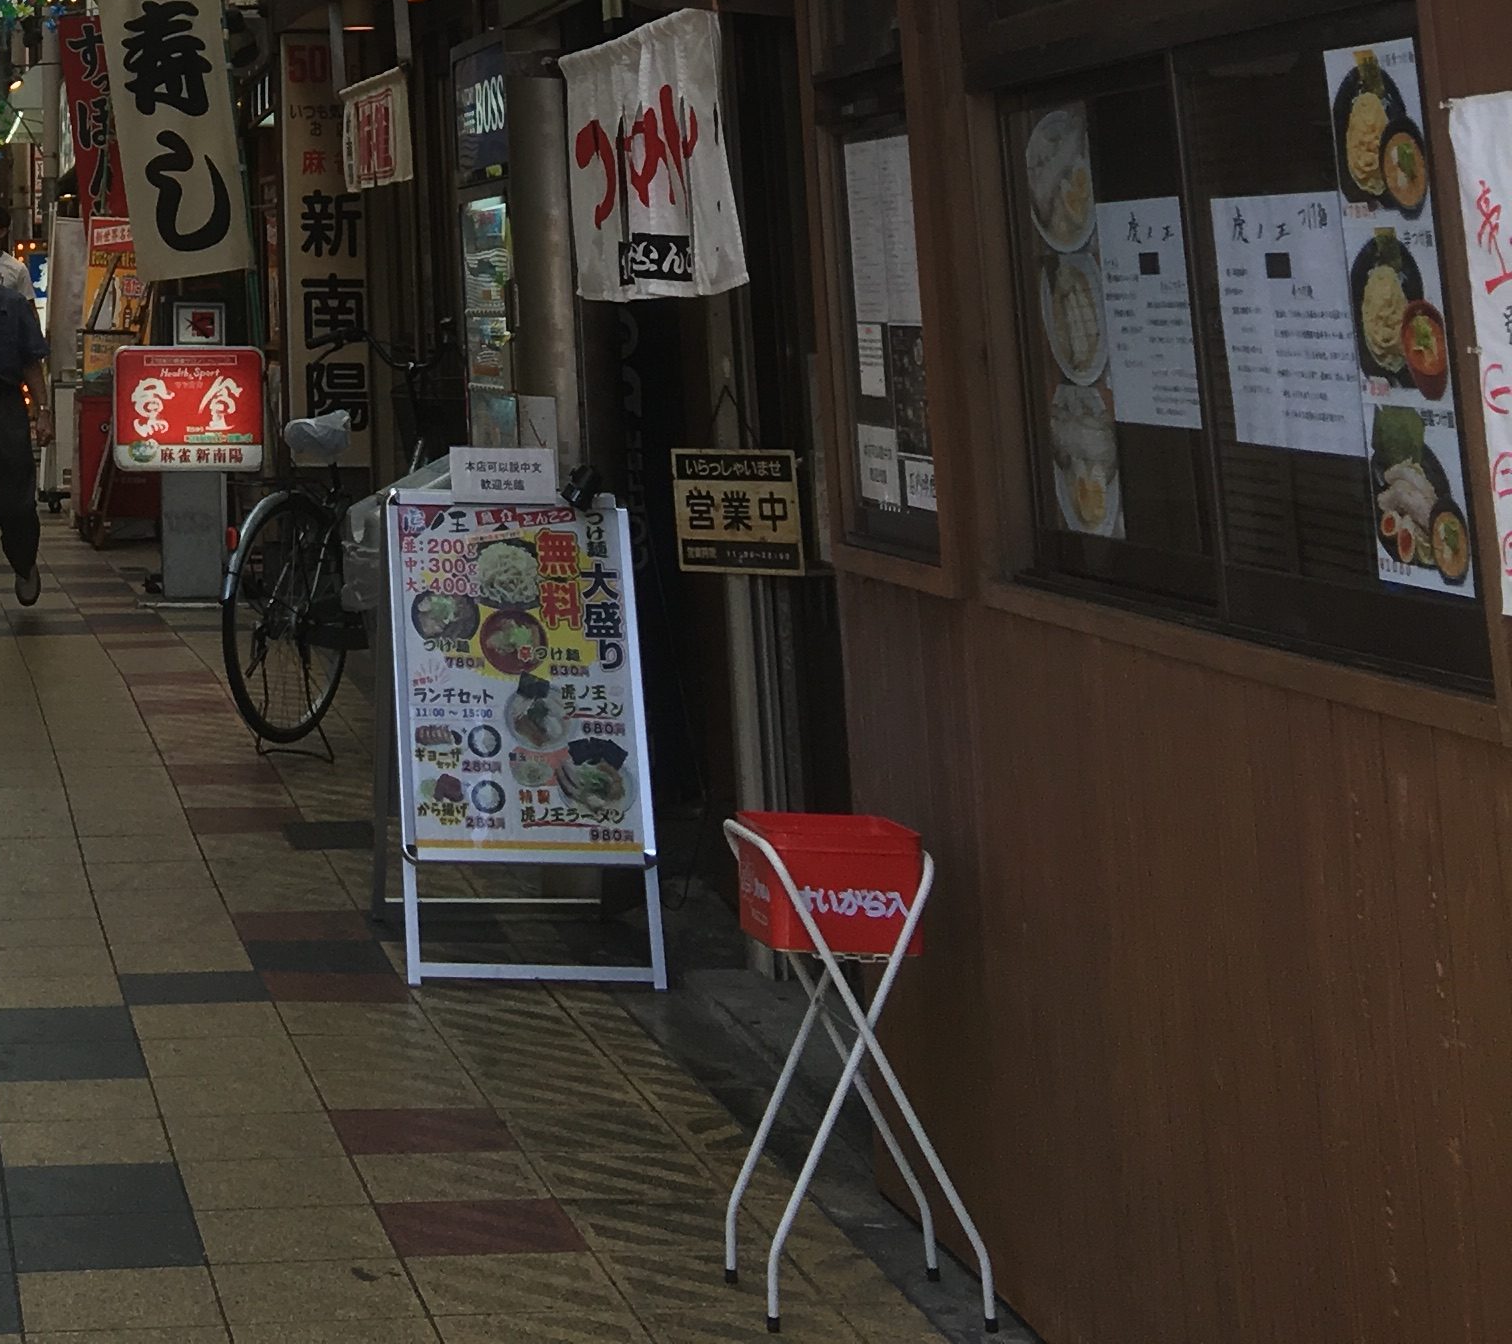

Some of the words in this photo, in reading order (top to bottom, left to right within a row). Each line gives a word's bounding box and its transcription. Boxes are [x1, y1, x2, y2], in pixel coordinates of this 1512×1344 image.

[476, 74, 505, 134] BOSS
[121, 0, 231, 251] 寿し
[300, 189, 371, 433] 新南陽
[161, 448, 191, 464] 麻雀
[196, 448, 244, 464] 新南陽
[685, 459, 782, 477] いらっしゃいませ
[686, 486, 788, 532] 営業中
[537, 529, 582, 628] 無料
[580, 562, 624, 670] 大盛り
[413, 687, 494, 705] ランチセット
[563, 702, 624, 717] ラーメン
[414, 747, 463, 762] ギョーザ
[521, 807, 625, 824] 虎ノ王ラーメン
